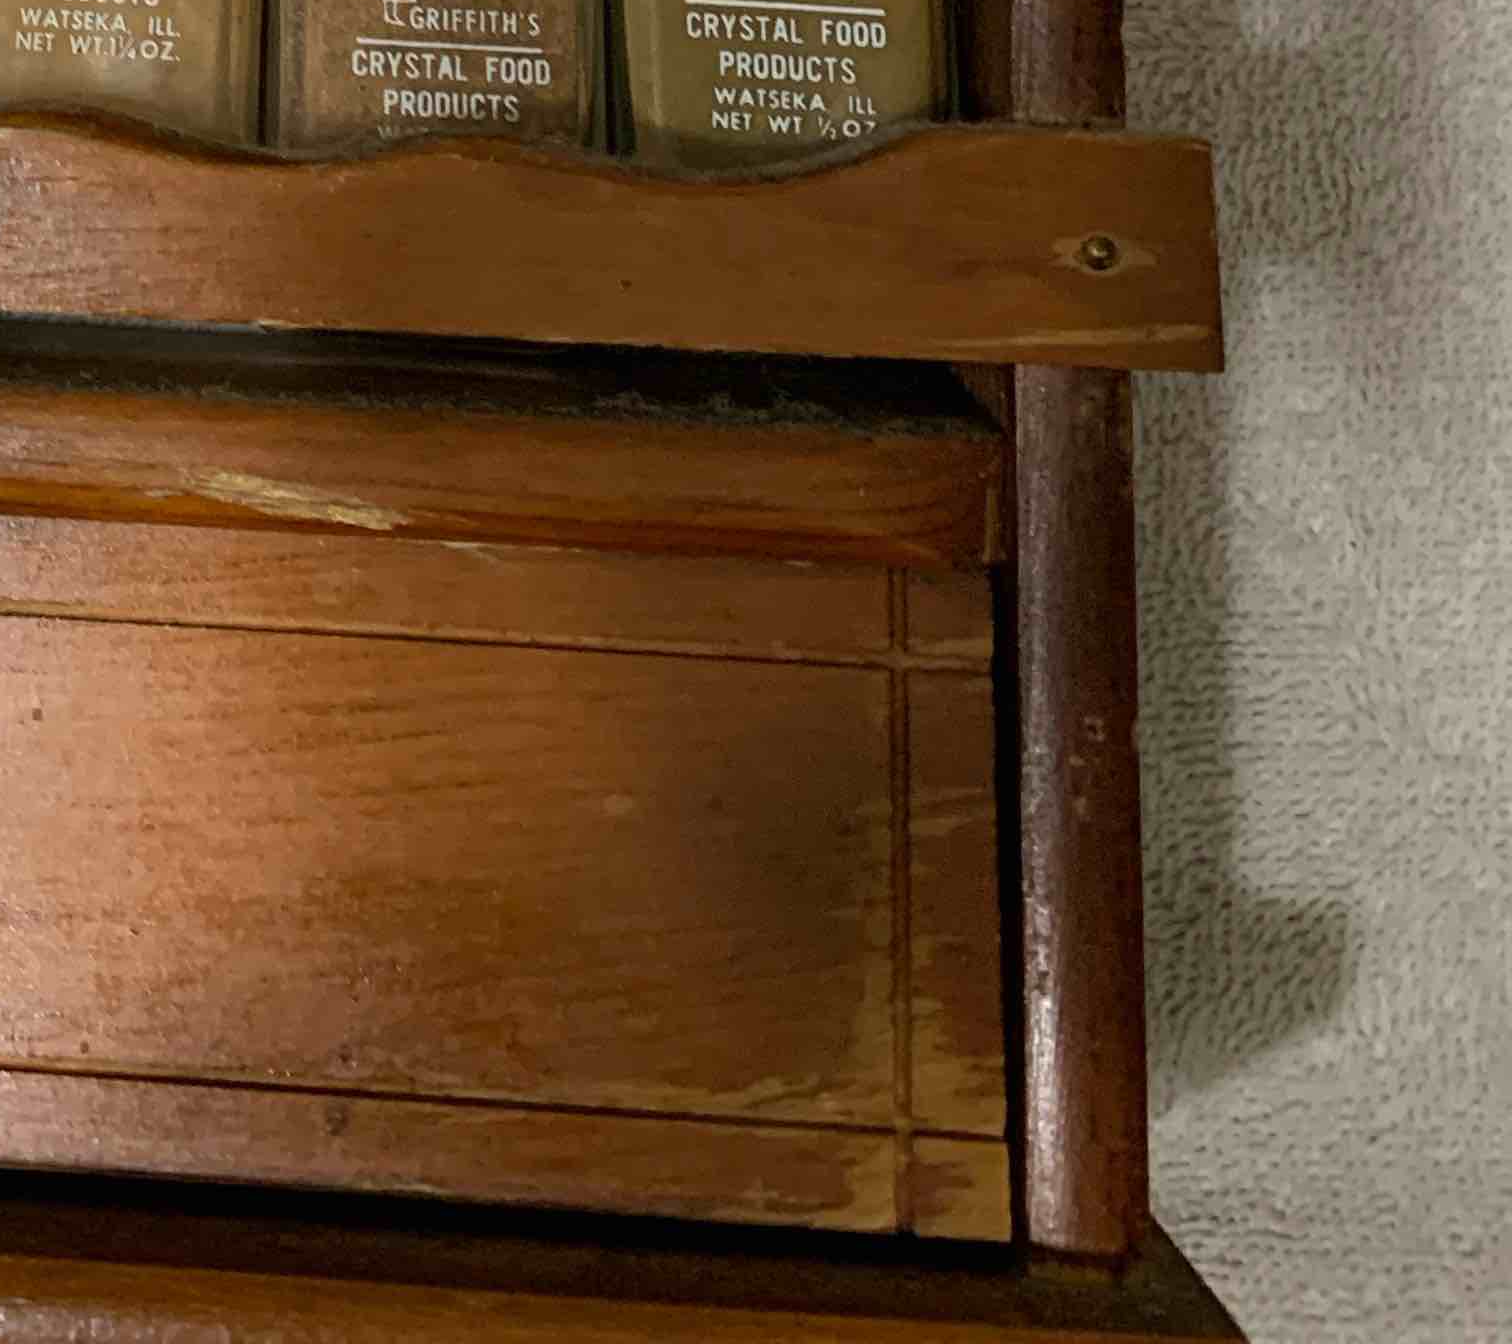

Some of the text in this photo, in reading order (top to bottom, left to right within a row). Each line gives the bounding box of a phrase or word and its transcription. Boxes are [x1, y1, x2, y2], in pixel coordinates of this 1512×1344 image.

[409, 4, 542, 38] GRIFFITH'S
[686, 11, 887, 49] CRYSTAL FOOD
[15, 29, 55, 53] NET
[351, 49, 552, 85] CRYSTAL FOOD
[718, 48, 857, 85] PRODUCTS
[383, 88, 521, 123] PRODUCTS
[711, 110, 753, 131] NET
